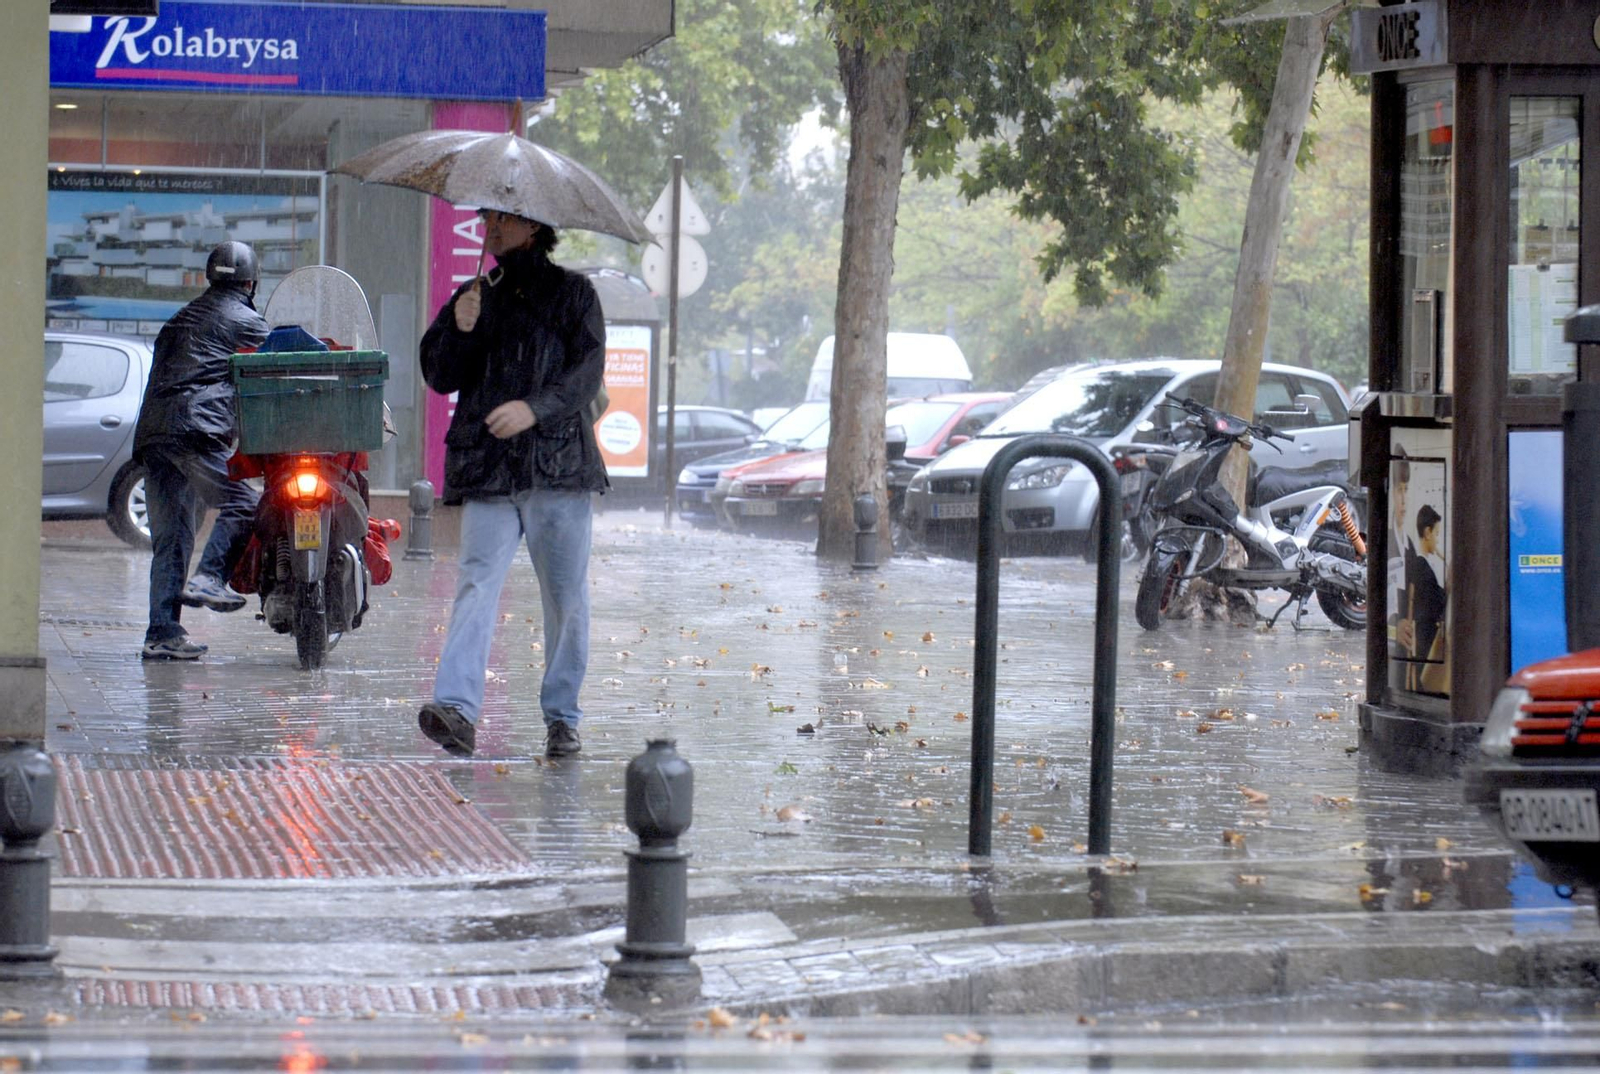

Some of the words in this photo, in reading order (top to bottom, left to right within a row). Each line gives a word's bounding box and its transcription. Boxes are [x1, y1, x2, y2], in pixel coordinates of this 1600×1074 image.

[96, 16, 299, 68] Rolabrysa
[1377, 10, 1421, 61] ONCE
[93, 176, 105, 187] la
[108, 176, 132, 187] vida
[136, 179, 157, 192] que
[1531, 556, 1559, 565] ONCE
